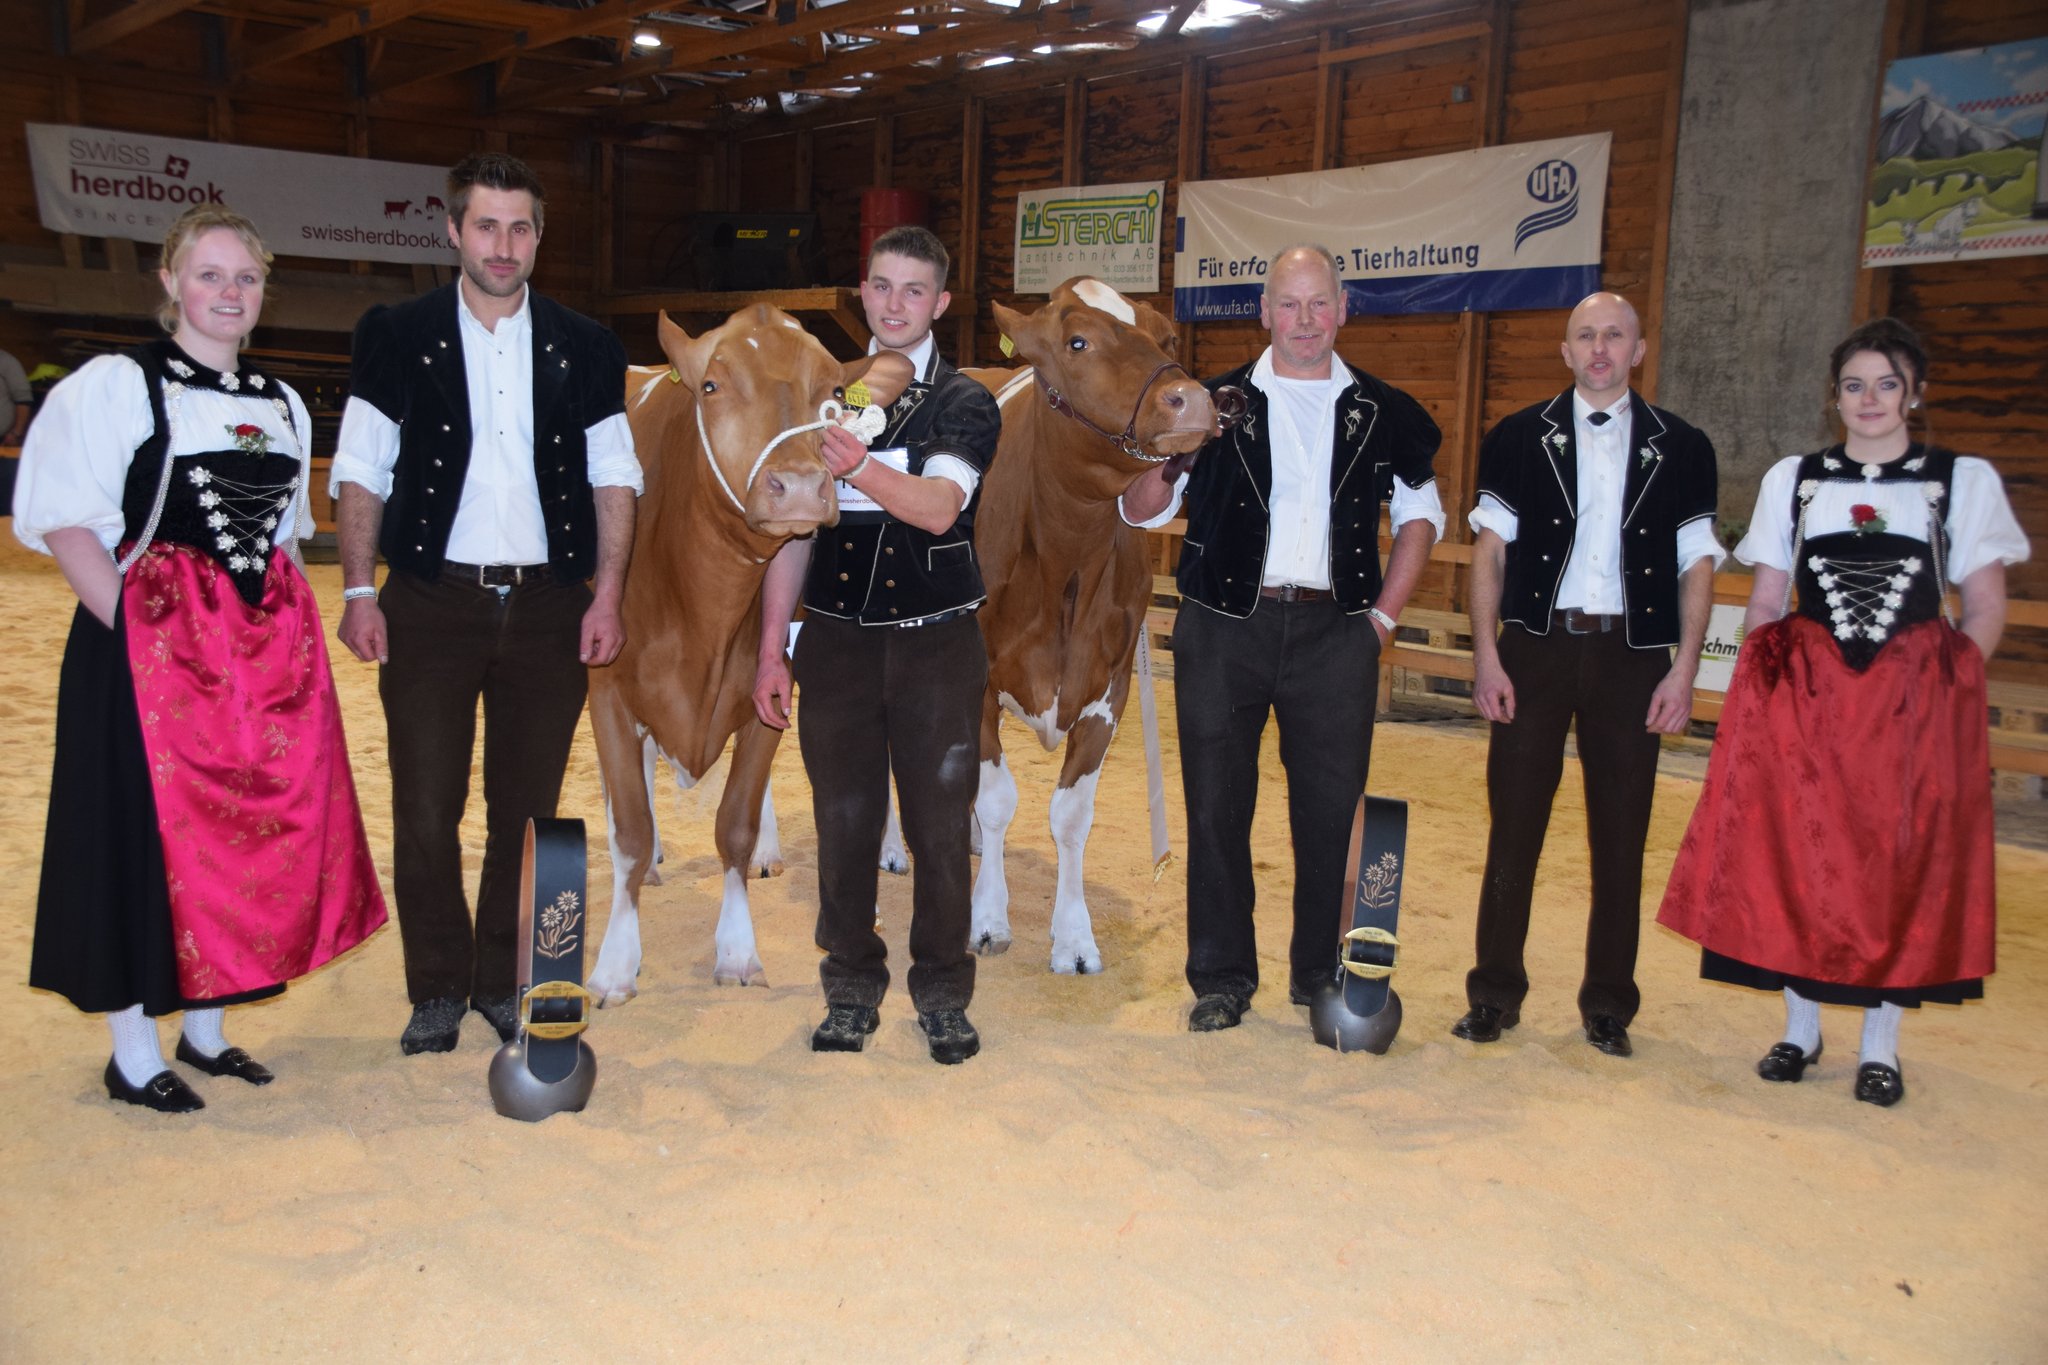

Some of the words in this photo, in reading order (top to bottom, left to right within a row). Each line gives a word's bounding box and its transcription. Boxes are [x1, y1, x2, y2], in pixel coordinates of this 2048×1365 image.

[70, 168, 225, 205] herdbook
[1532, 162, 1571, 201] UFA
[74, 208, 156, 226] SINCE
[1020, 249, 1117, 264] andtechnik
[1133, 246, 1155, 260] AG
[1198, 257, 1224, 279] Für
[1351, 243, 1480, 268] Tierhaltung
[1195, 299, 1256, 316] www.ufa.ch
